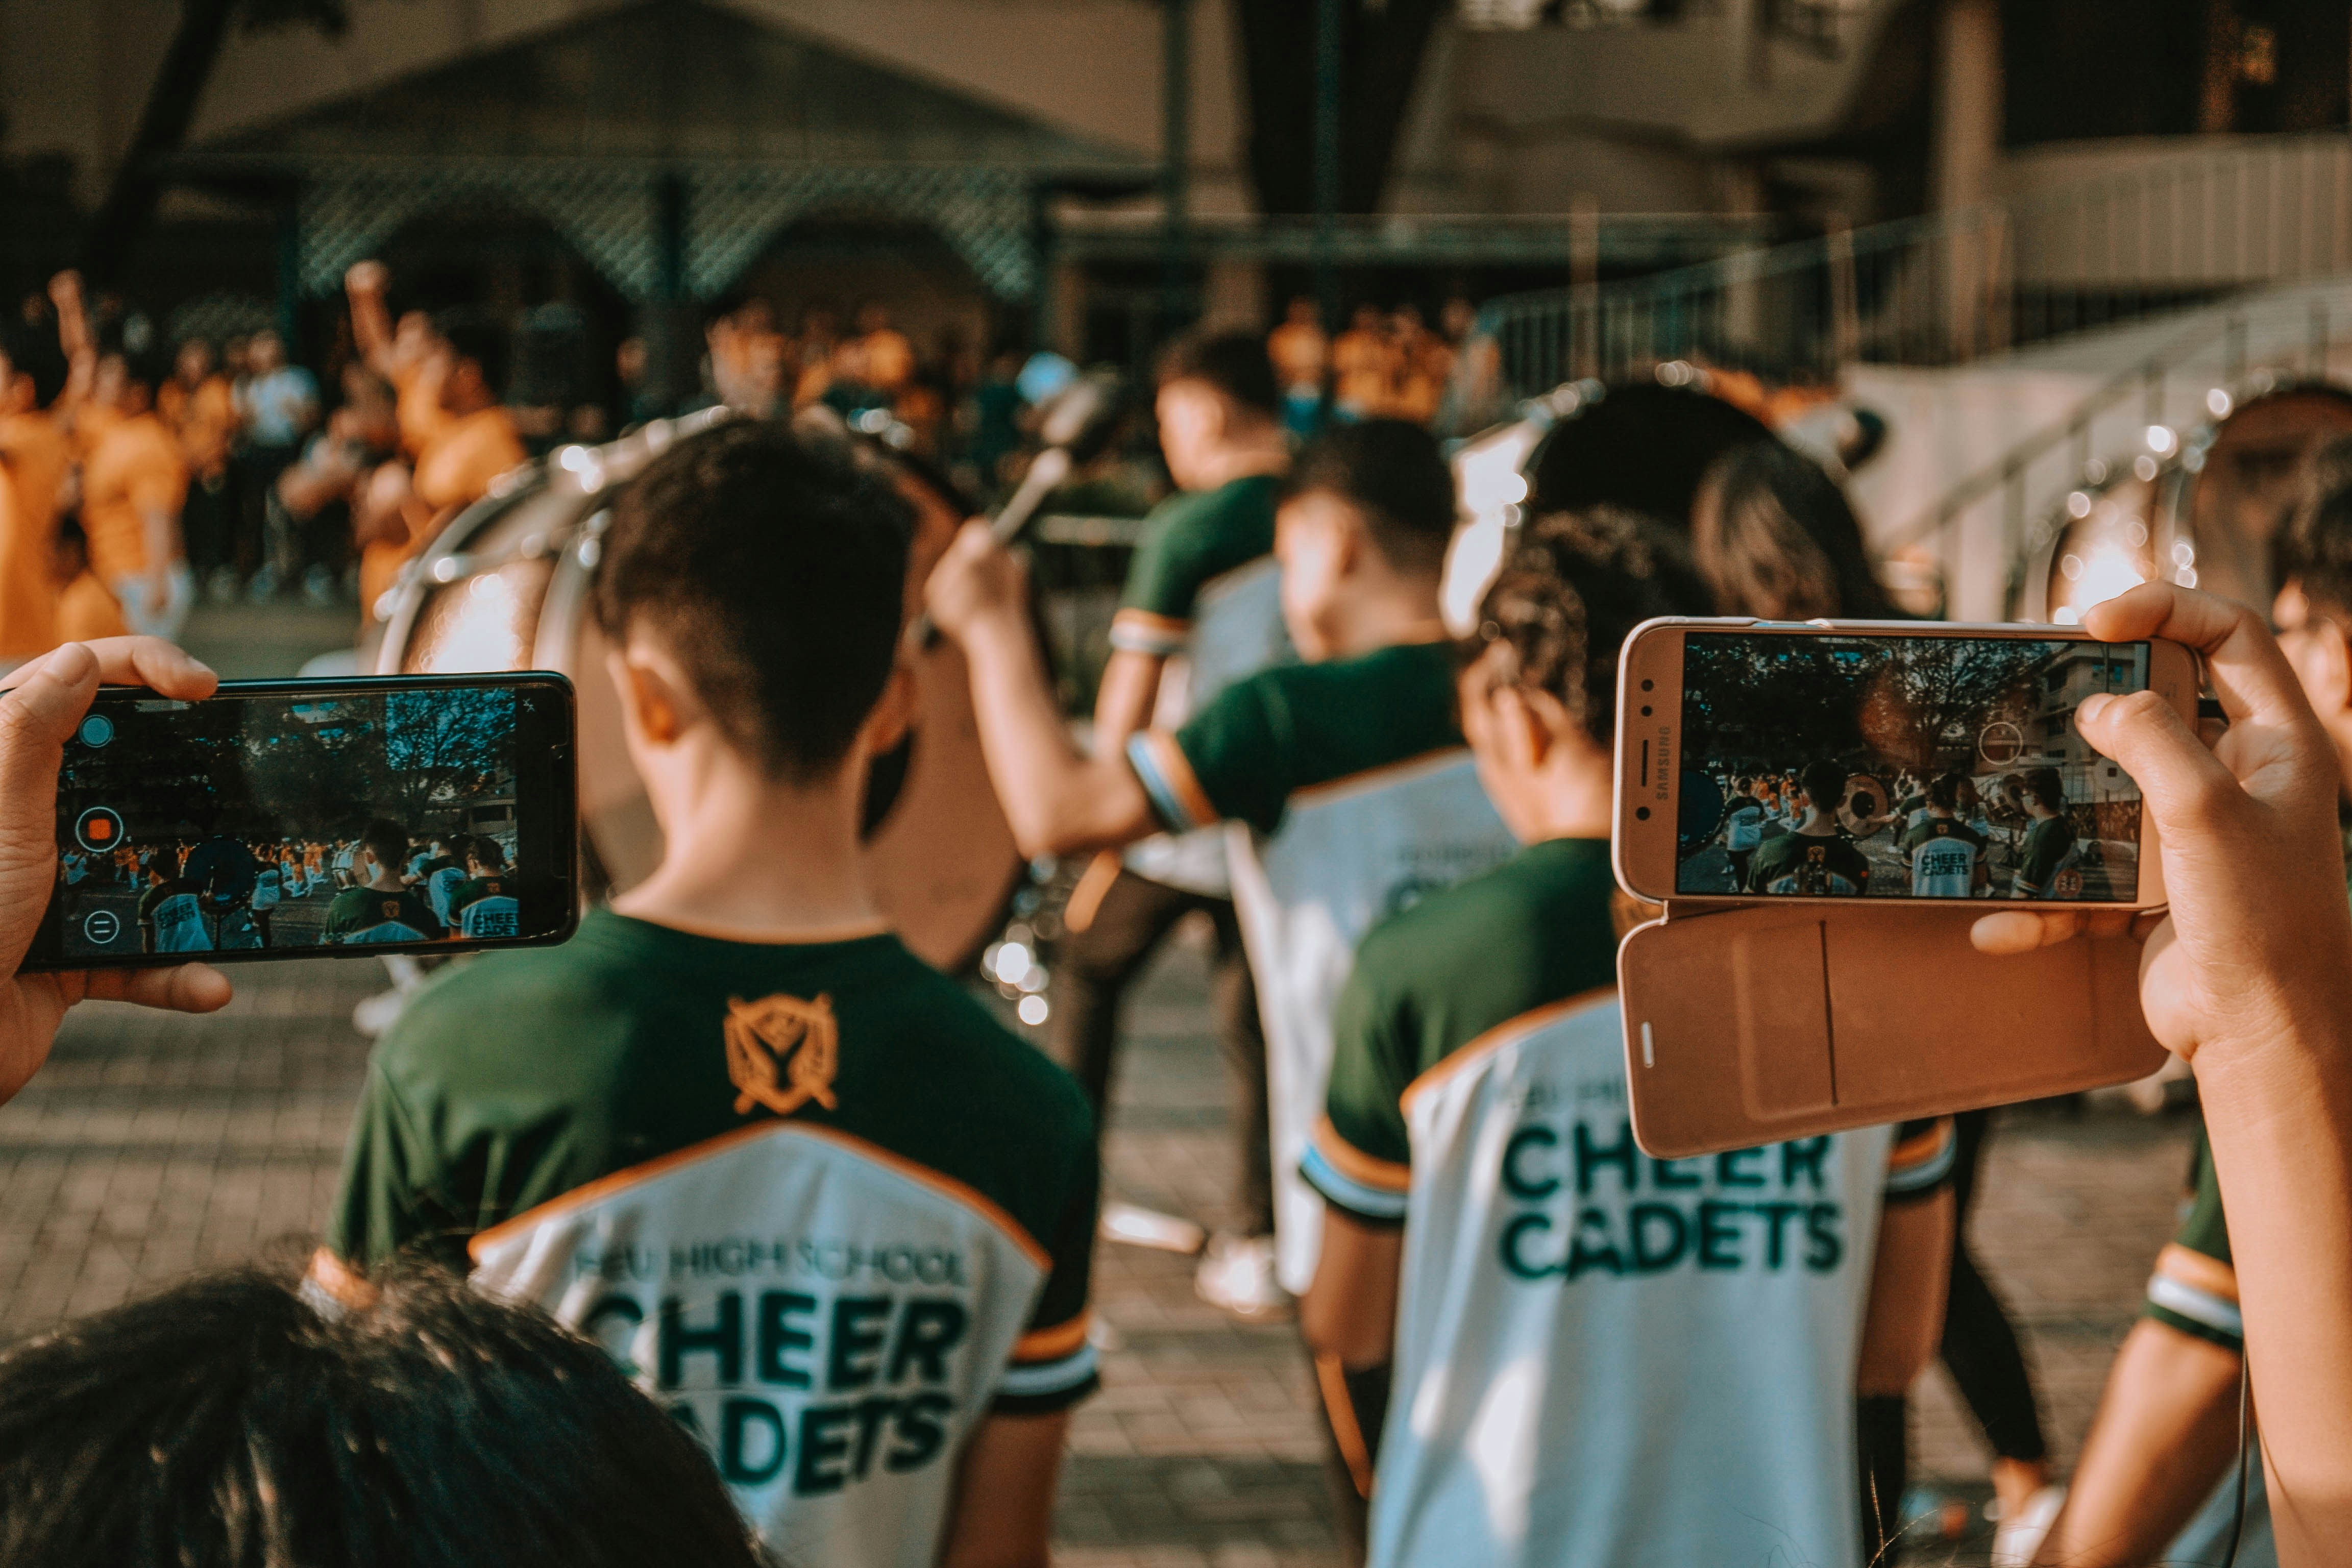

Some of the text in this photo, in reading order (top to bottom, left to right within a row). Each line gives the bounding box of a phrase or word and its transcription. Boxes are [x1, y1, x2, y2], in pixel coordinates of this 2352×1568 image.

[1655, 726, 1671, 800] SAMSUNG
[1921, 852, 1966, 866] CHEER
[473, 913, 518, 925] CHEE
[669, 1237, 788, 1279] HIGH
[796, 1238, 964, 1287] SCHOOL
[1500, 1200, 1845, 1282] CADETS
[669, 1392, 954, 1498] DETS
